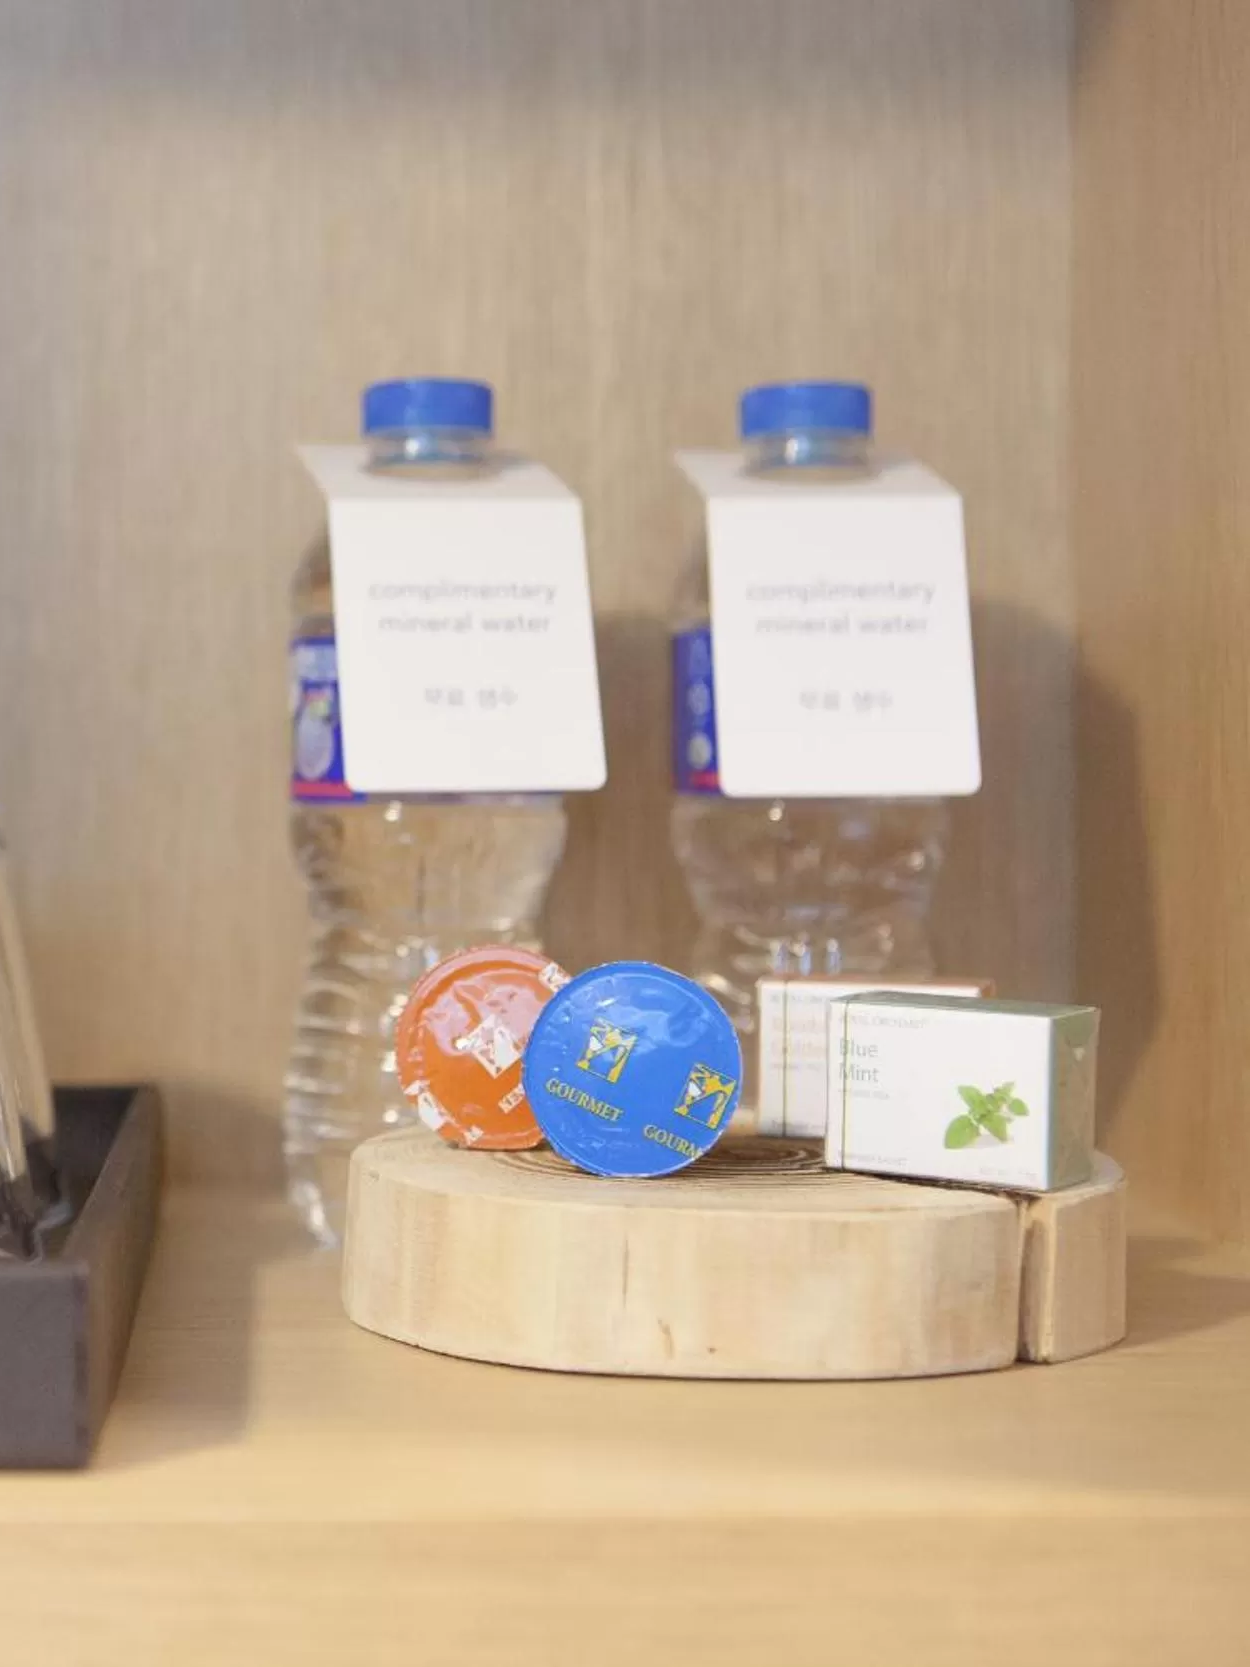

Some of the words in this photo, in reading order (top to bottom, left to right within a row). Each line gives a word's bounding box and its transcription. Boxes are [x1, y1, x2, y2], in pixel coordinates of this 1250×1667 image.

[368, 580, 557, 605] complimentary
[745, 579, 935, 605] complimentary
[378, 611, 472, 633] mineral
[482, 613, 550, 633] water
[755, 611, 849, 634] mineral
[859, 614, 928, 634] water
[839, 1037, 879, 1058] Blue
[838, 1062, 880, 1083] Mint
[545, 1077, 624, 1122] GOURMET
